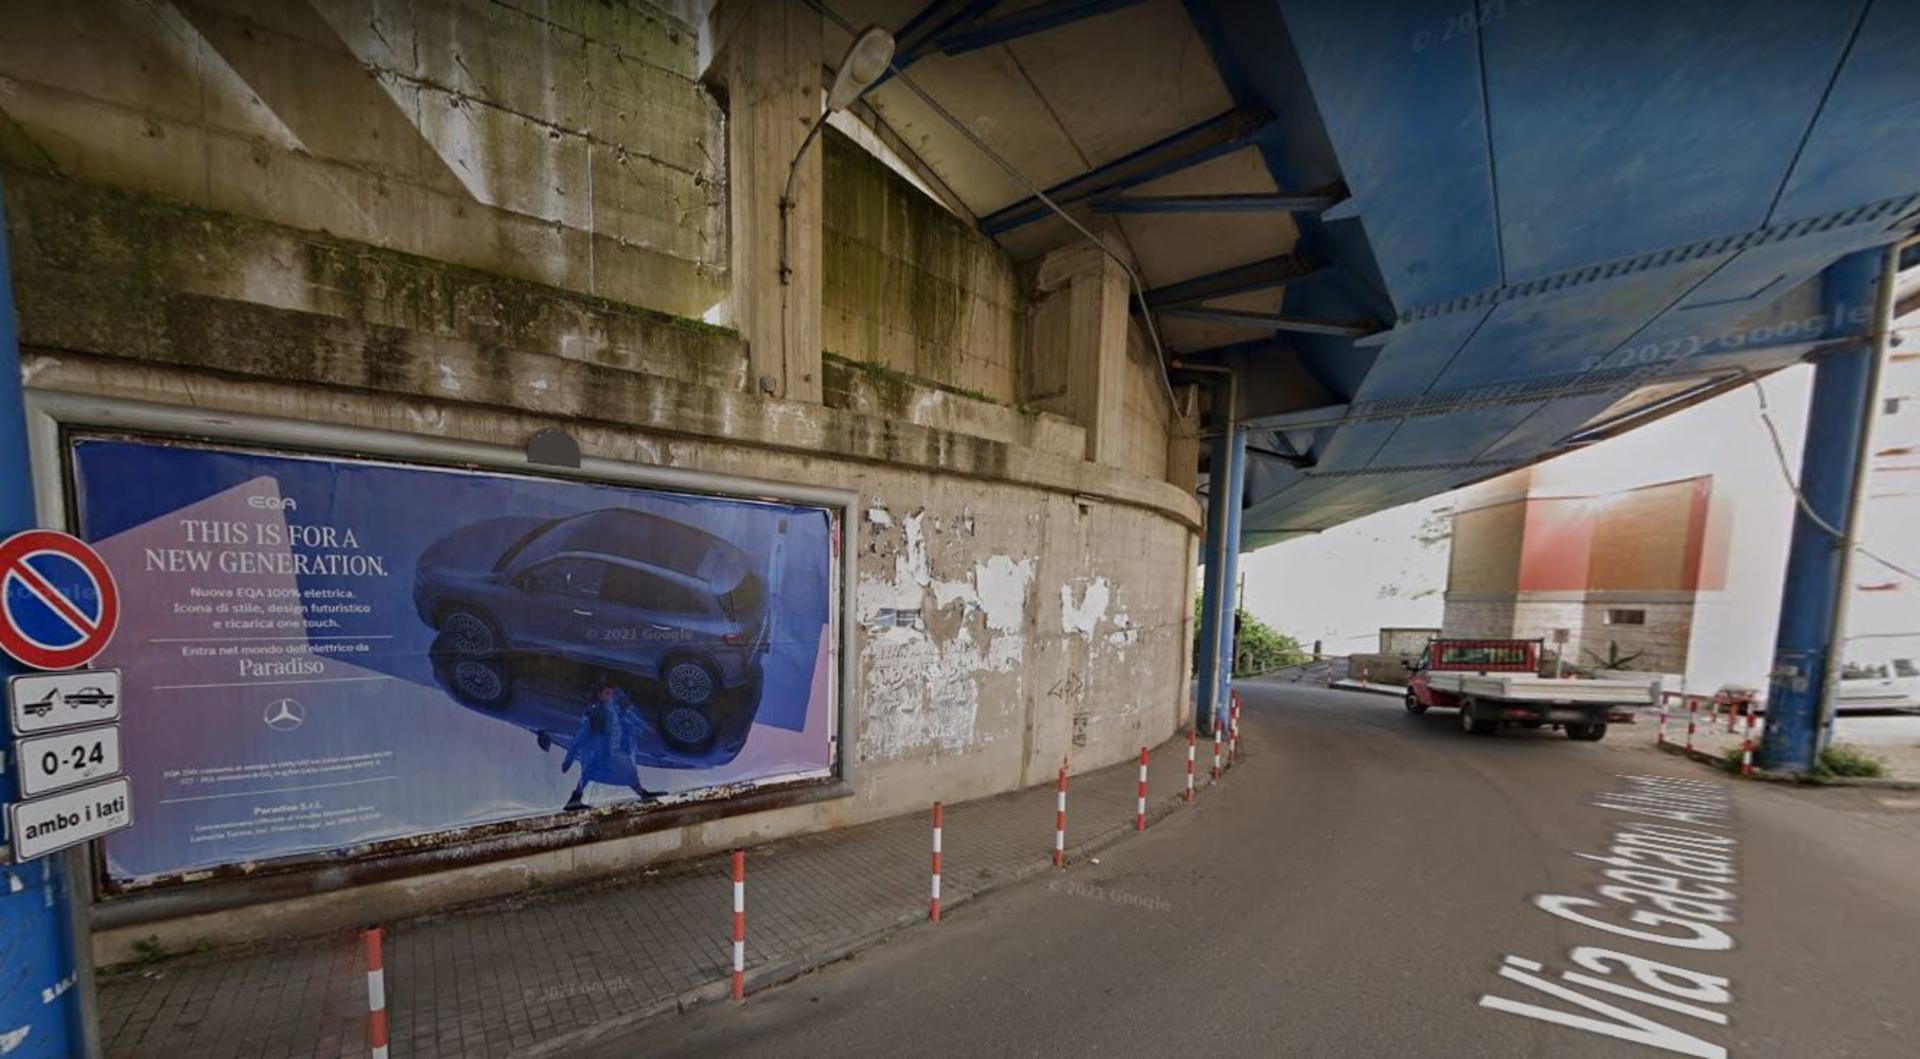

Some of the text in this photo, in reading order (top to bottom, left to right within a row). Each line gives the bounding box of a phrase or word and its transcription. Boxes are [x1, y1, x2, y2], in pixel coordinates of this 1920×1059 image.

[247, 495, 298, 510] EQA
[180, 520, 359, 548] THIS IS FOR A
[144, 549, 388, 577] NEW GENERATION.
[190, 588, 356, 599] Nuova EQA 100% elettrica.
[174, 603, 371, 616] Icona di stile, design futuristico
[213, 619, 340, 629] e ricarica one touch.
[182, 643, 369, 657] Entra nel mondo dell'elettrico da
[238, 657, 324, 677] Paradiso
[42, 740, 104, 776] 0-24
[25, 809, 80, 839] ambo
[85, 804, 91, 822] i
[96, 795, 125, 819] lati
